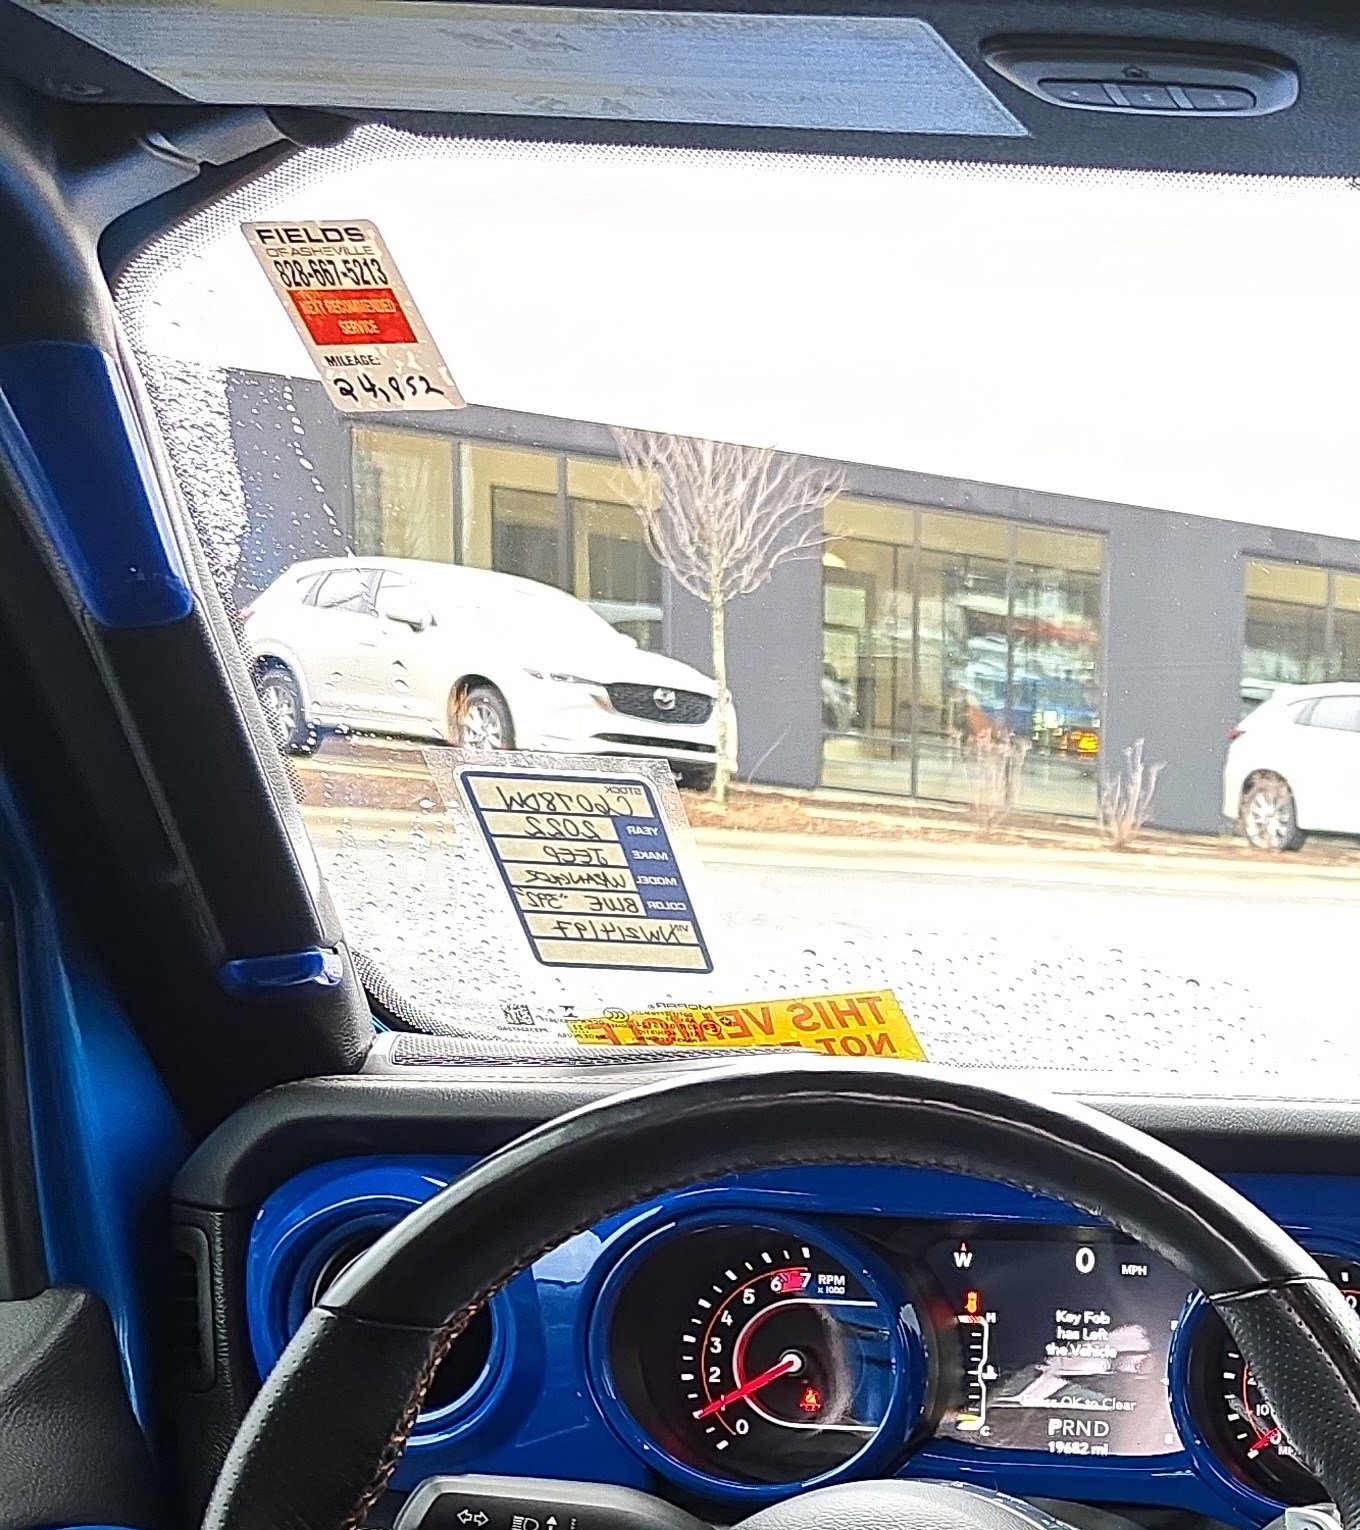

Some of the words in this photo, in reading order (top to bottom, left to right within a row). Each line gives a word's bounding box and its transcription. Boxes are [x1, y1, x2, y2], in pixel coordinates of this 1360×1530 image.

[255, 227, 365, 244] FIELDS
[265, 247, 290, 257] OF
[291, 245, 375, 256] ASHEVILLE
[274, 258, 389, 288] 828-667-5213
[324, 299, 396, 314] RECOMMENDED
[338, 319, 380, 335] SERVICE
[324, 355, 382, 367] MILEAGE:
[953, 1251, 972, 1268] W
[1075, 1247, 1095, 1273] 0
[1121, 1265, 1147, 1276] MPH
[771, 1277, 783, 1292] 6
[801, 1273, 811, 1288] 7
[818, 1274, 845, 1286] RPM
[743, 1289, 755, 1304] 5
[721, 1310, 733, 1326] 4
[985, 1312, 997, 1323] H
[1055, 1309, 1081, 1325] Key
[1083, 1310, 1111, 1325] Fob
[710, 1337, 722, 1353] 3
[708, 1367, 721, 1383] 2
[1256, 1403, 1269, 1417] 10
[735, 1419, 749, 1434] 0
[979, 1425, 990, 1437] C
[1048, 1418, 1110, 1437] PRND
